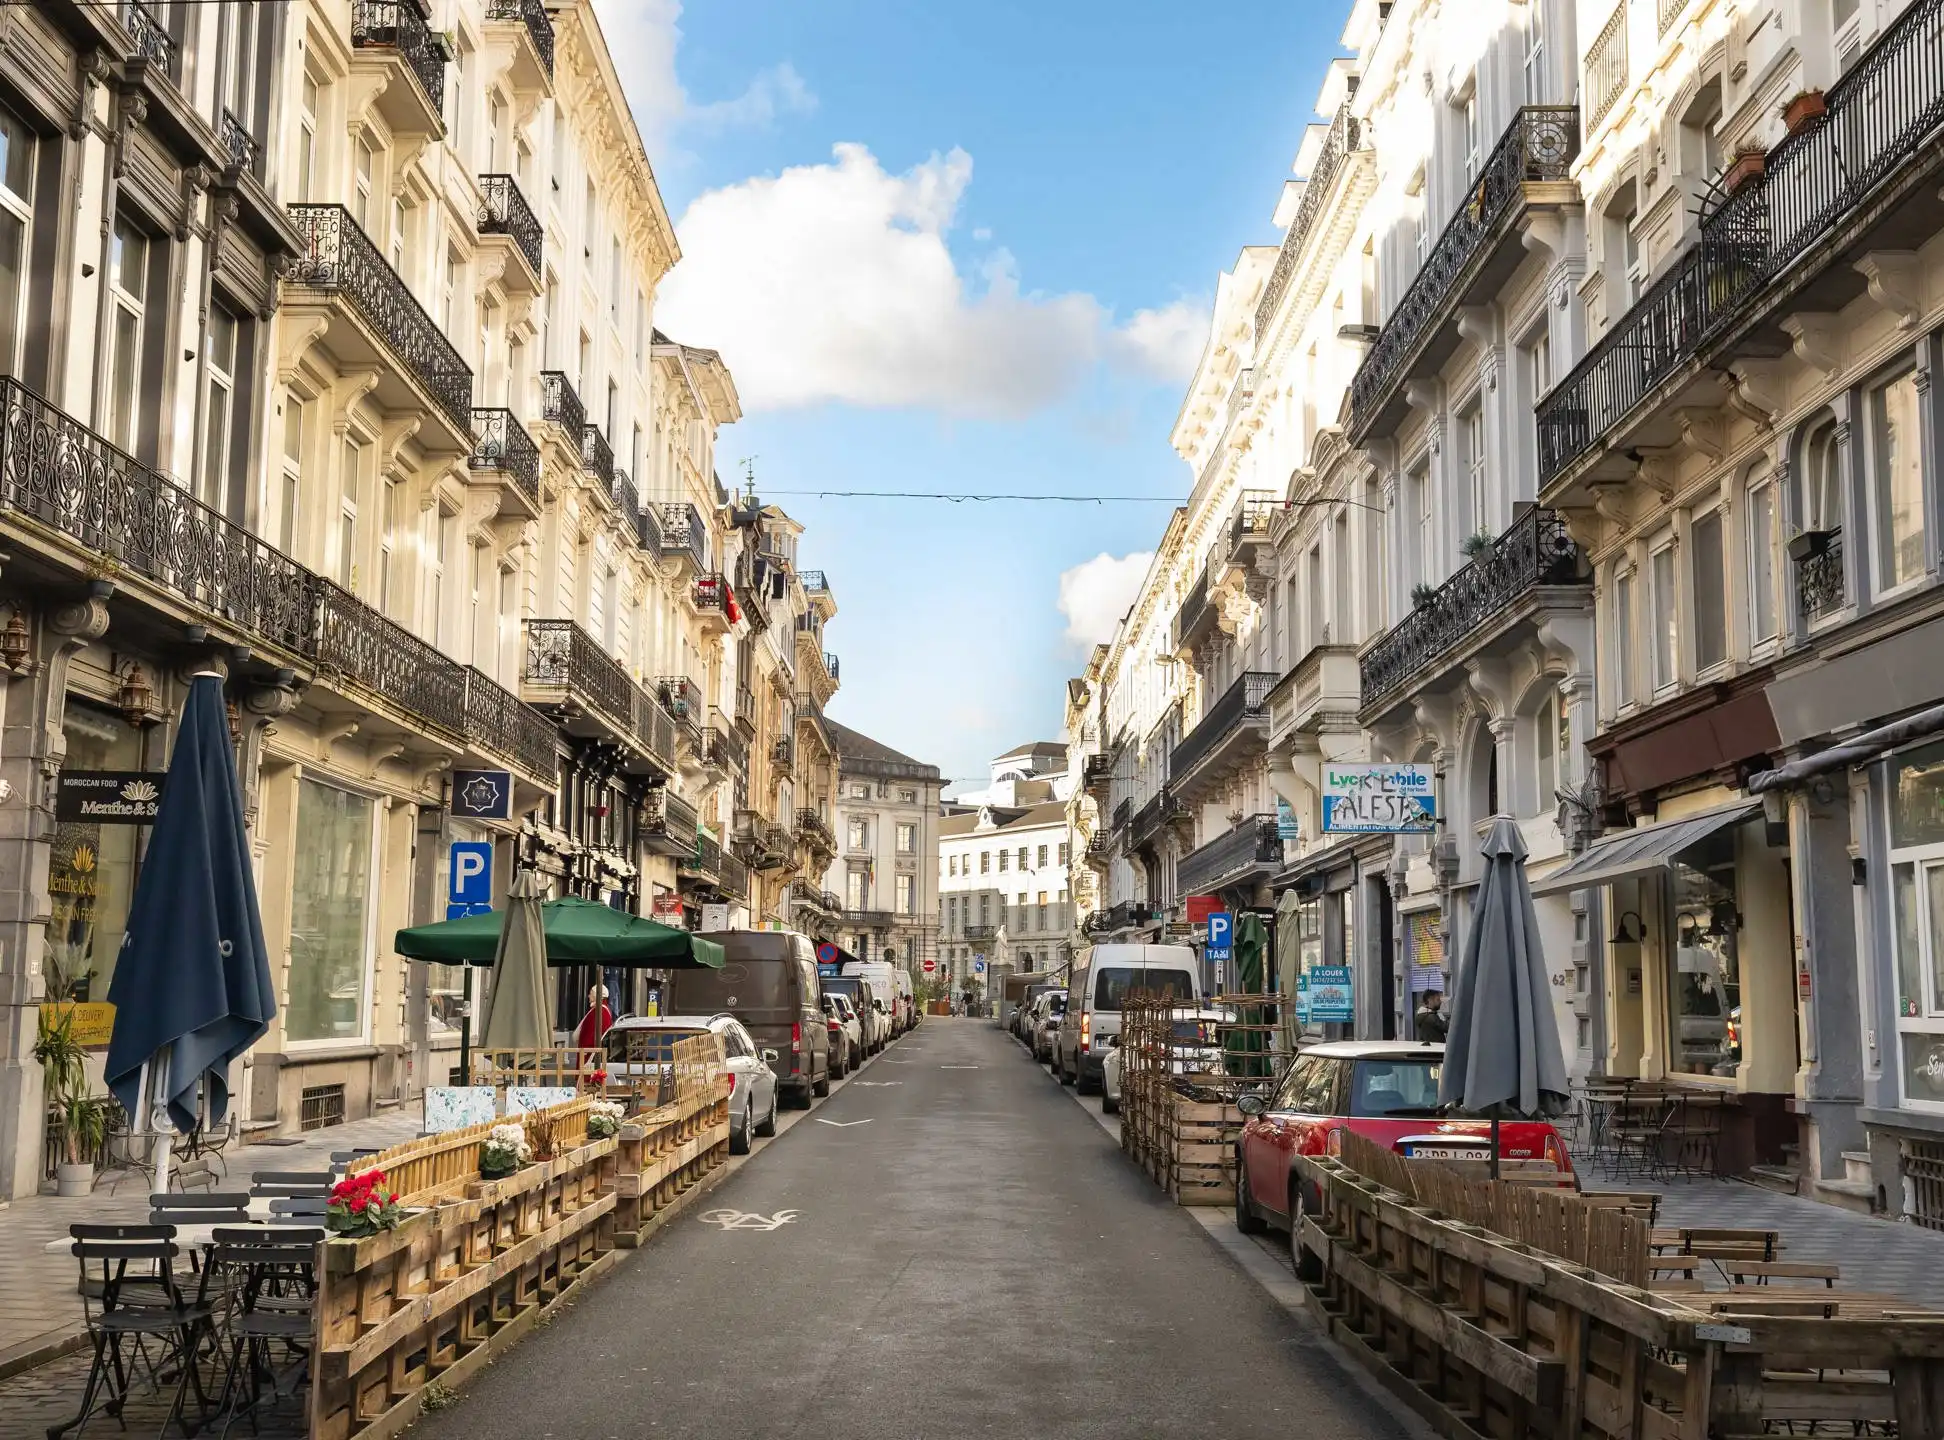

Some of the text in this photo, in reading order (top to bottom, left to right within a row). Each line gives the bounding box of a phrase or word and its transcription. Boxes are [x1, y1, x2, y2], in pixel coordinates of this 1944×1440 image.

[63, 778, 118, 788] MOROCCAN FOOD
[81, 800, 133, 815] Menthe
[133, 802, 145, 815] &
[456, 852, 485, 894] P
[1211, 918, 1228, 942] P
[1321, 969, 1344, 977] LOUER
[1552, 974, 1565, 986] 62
[78, 1009, 105, 1022] DELIVERY
